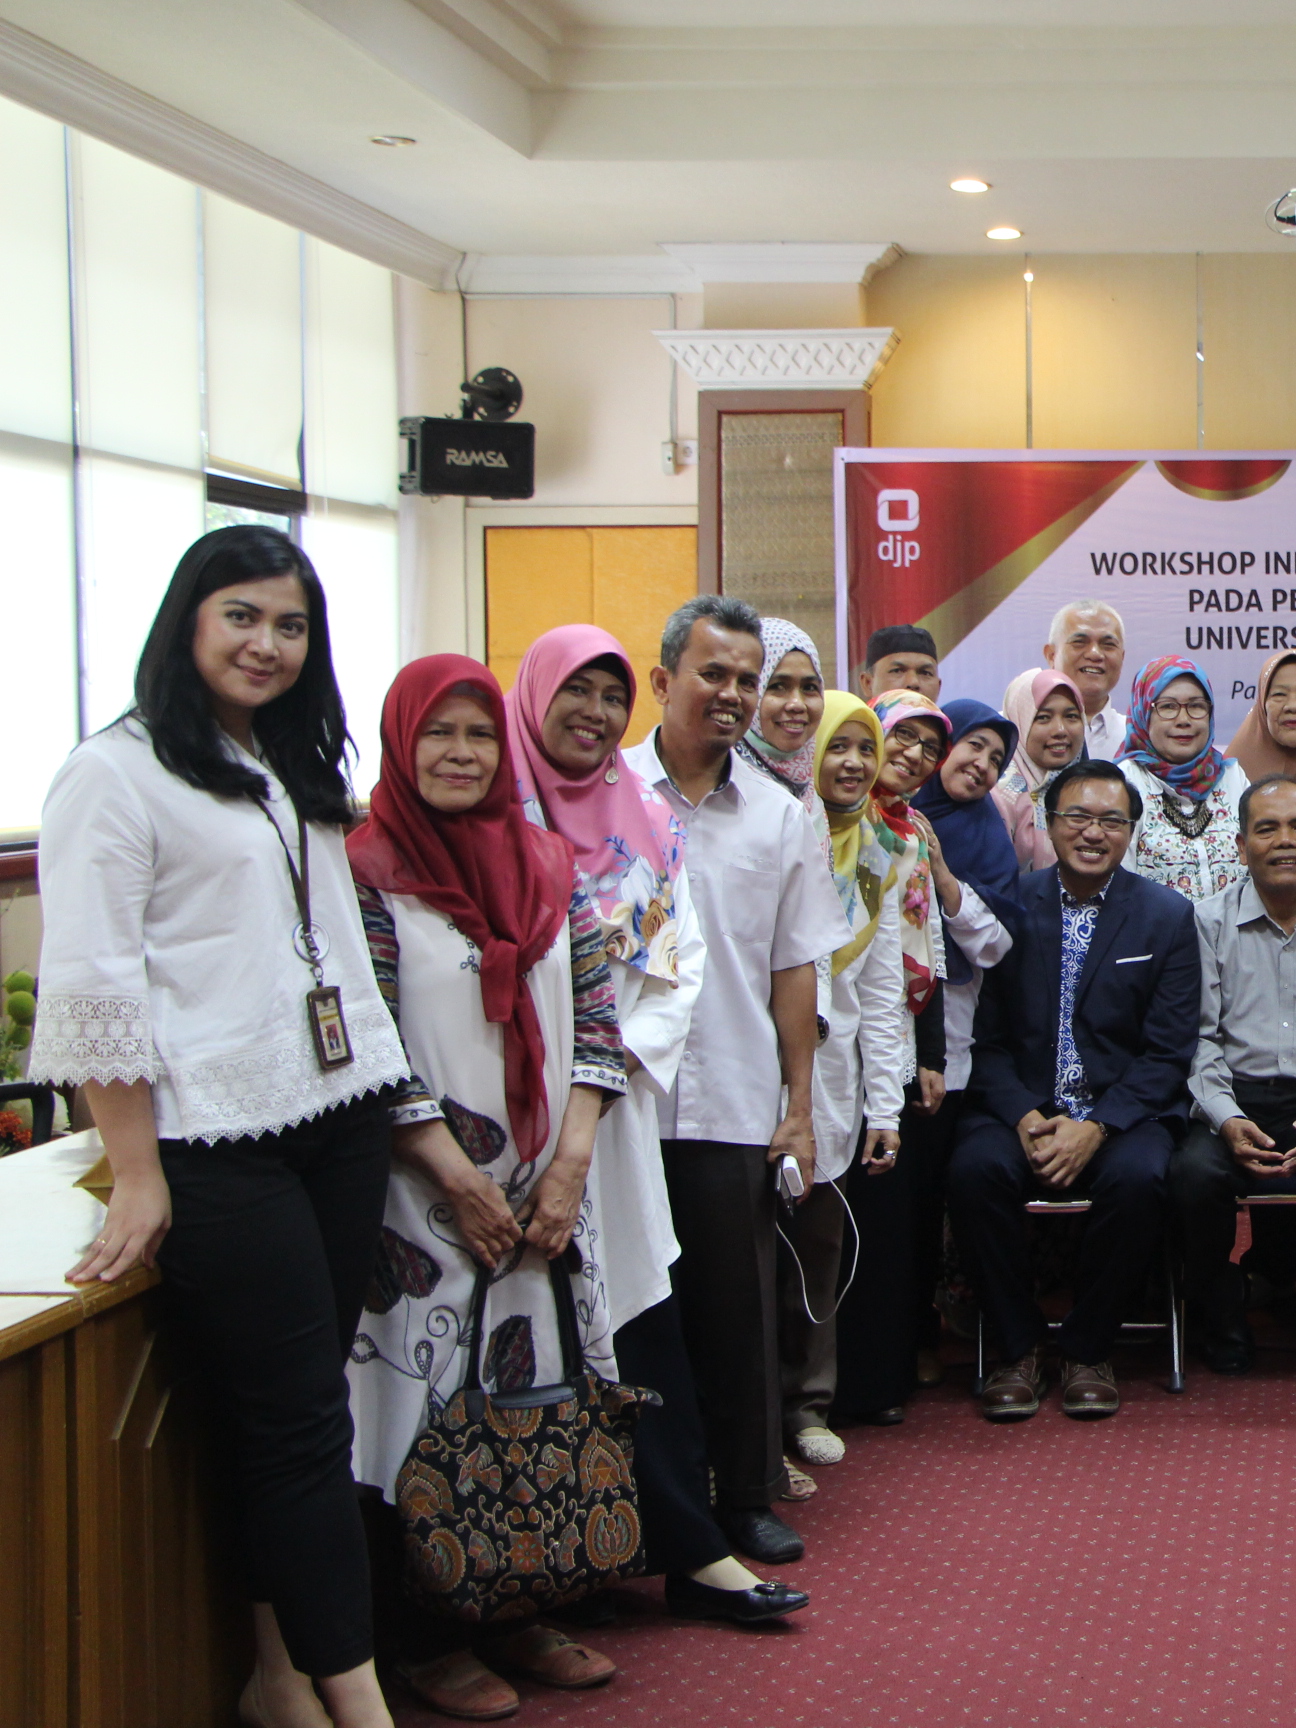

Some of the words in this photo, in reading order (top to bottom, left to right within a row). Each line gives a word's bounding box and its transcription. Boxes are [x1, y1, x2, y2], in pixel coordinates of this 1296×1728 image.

[445, 448, 509, 468] RAMSA
[878, 534, 920, 567] djp
[1090, 551, 1256, 576] WORKSHOP
[1188, 588, 1264, 613] PADA
